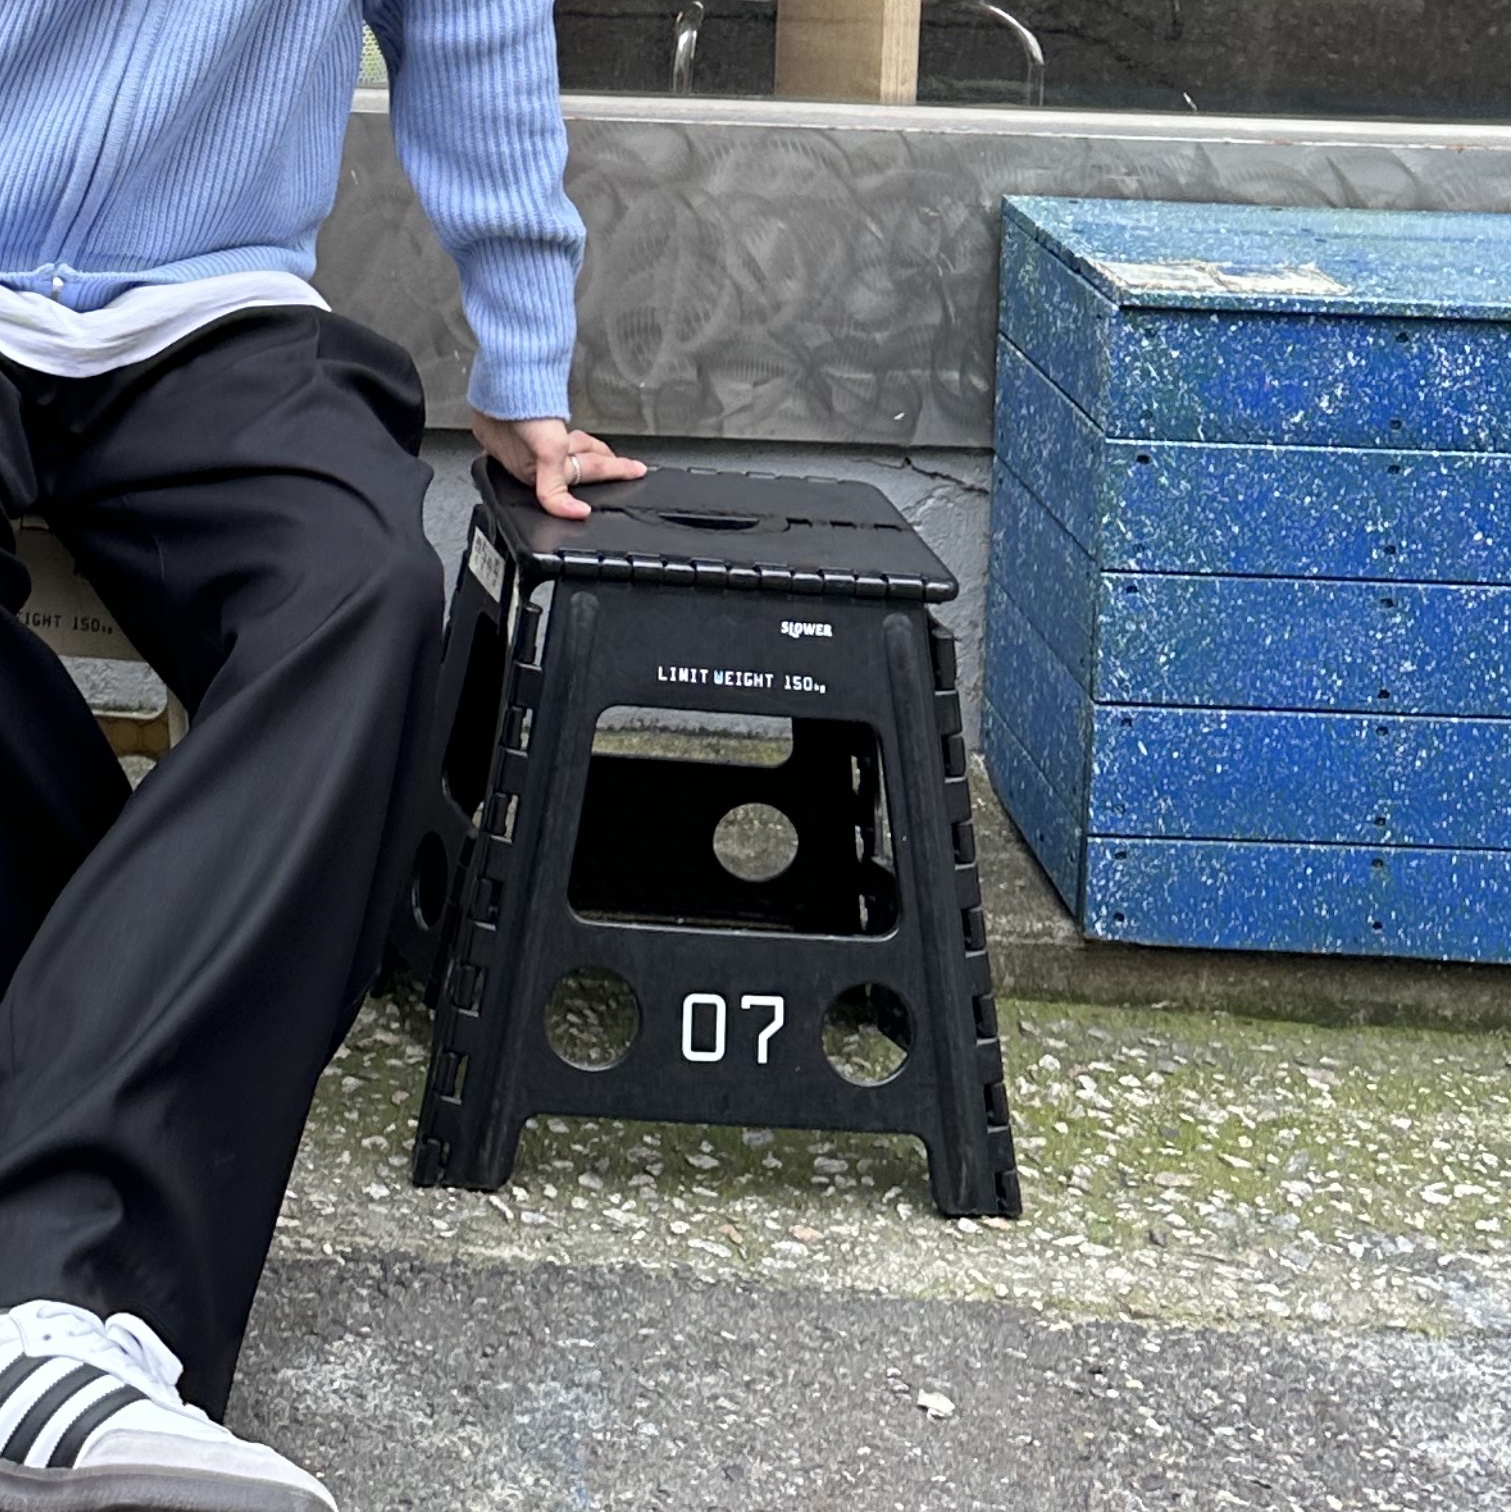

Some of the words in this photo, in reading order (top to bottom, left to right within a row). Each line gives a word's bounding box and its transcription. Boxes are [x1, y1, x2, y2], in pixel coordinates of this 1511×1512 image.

[780, 621, 833, 638] SLOWER
[658, 666, 709, 684] LIMIT
[713, 669, 774, 688] WEIGHT
[681, 992, 785, 1064] 07
